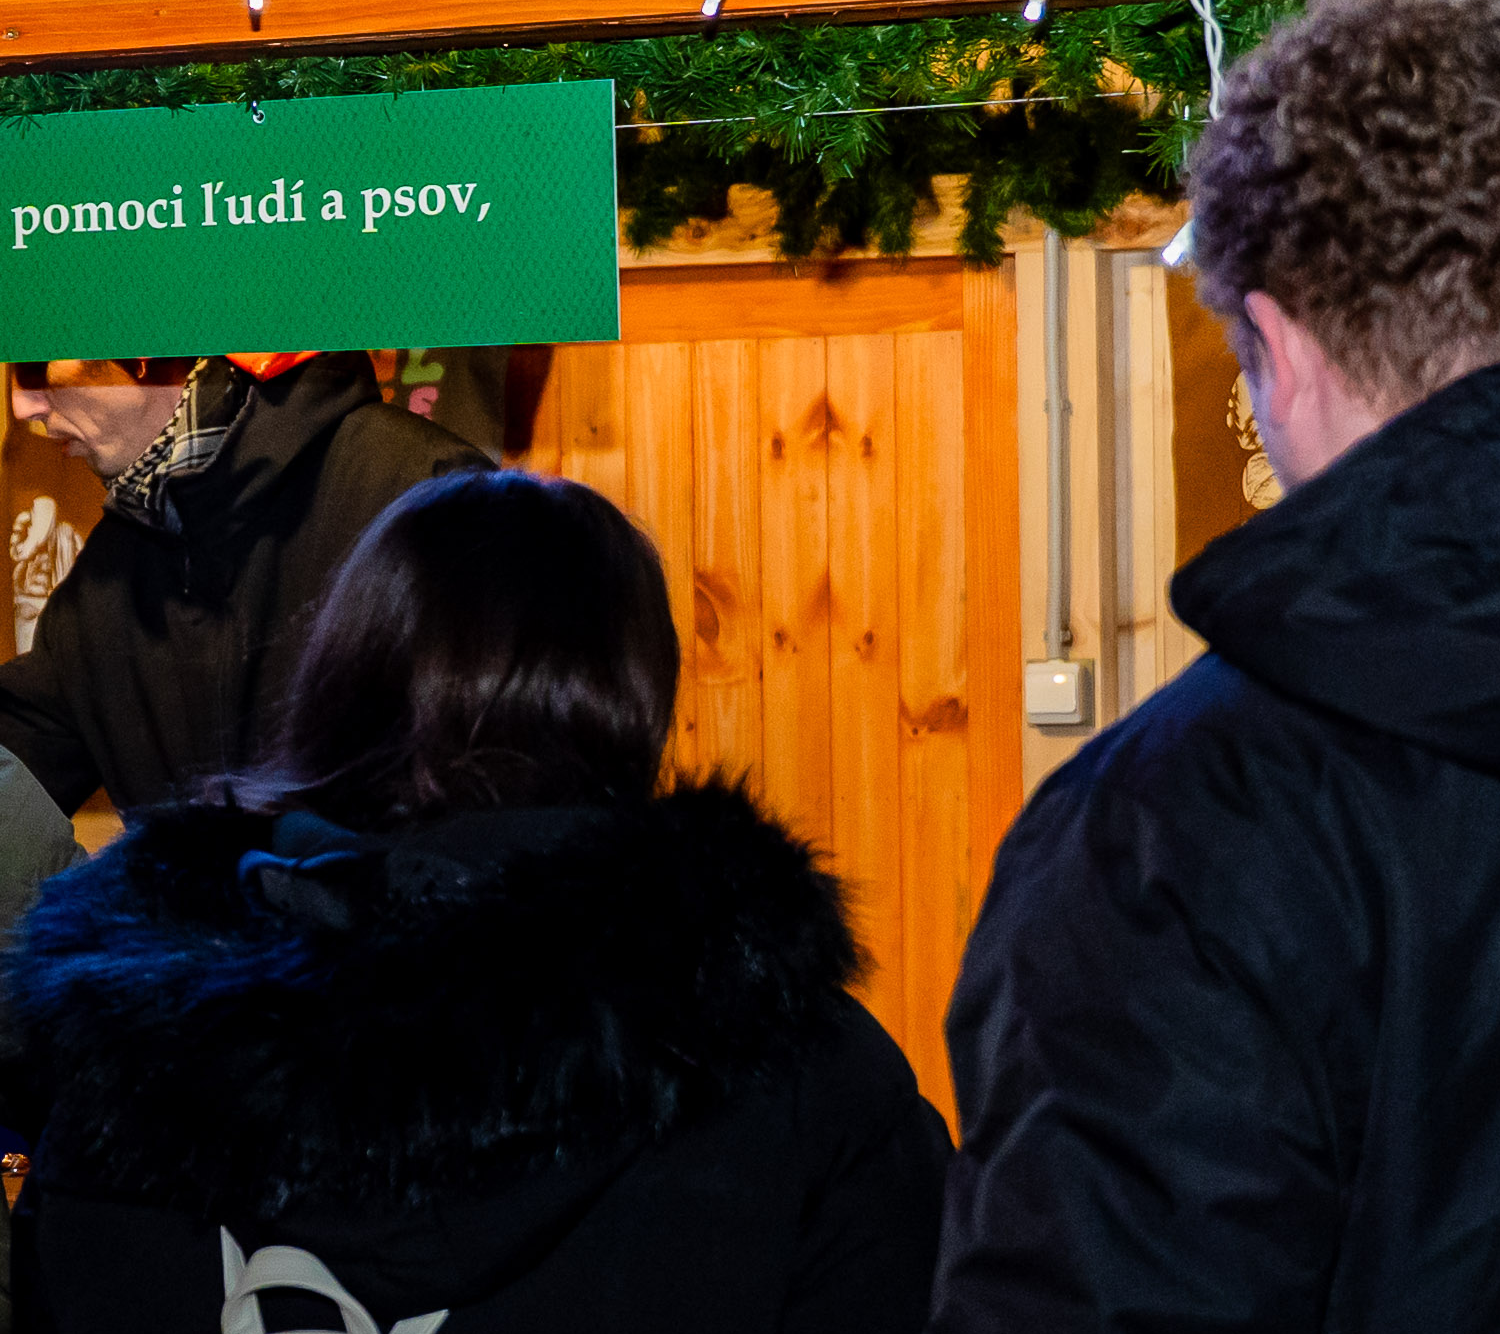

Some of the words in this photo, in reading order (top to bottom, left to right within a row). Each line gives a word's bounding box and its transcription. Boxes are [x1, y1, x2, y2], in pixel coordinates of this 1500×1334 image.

[10, 184, 187, 250] pomoci
[200, 178, 307, 227] ľudí
[320, 188, 347, 221] a
[360, 182, 492, 233] psov,
